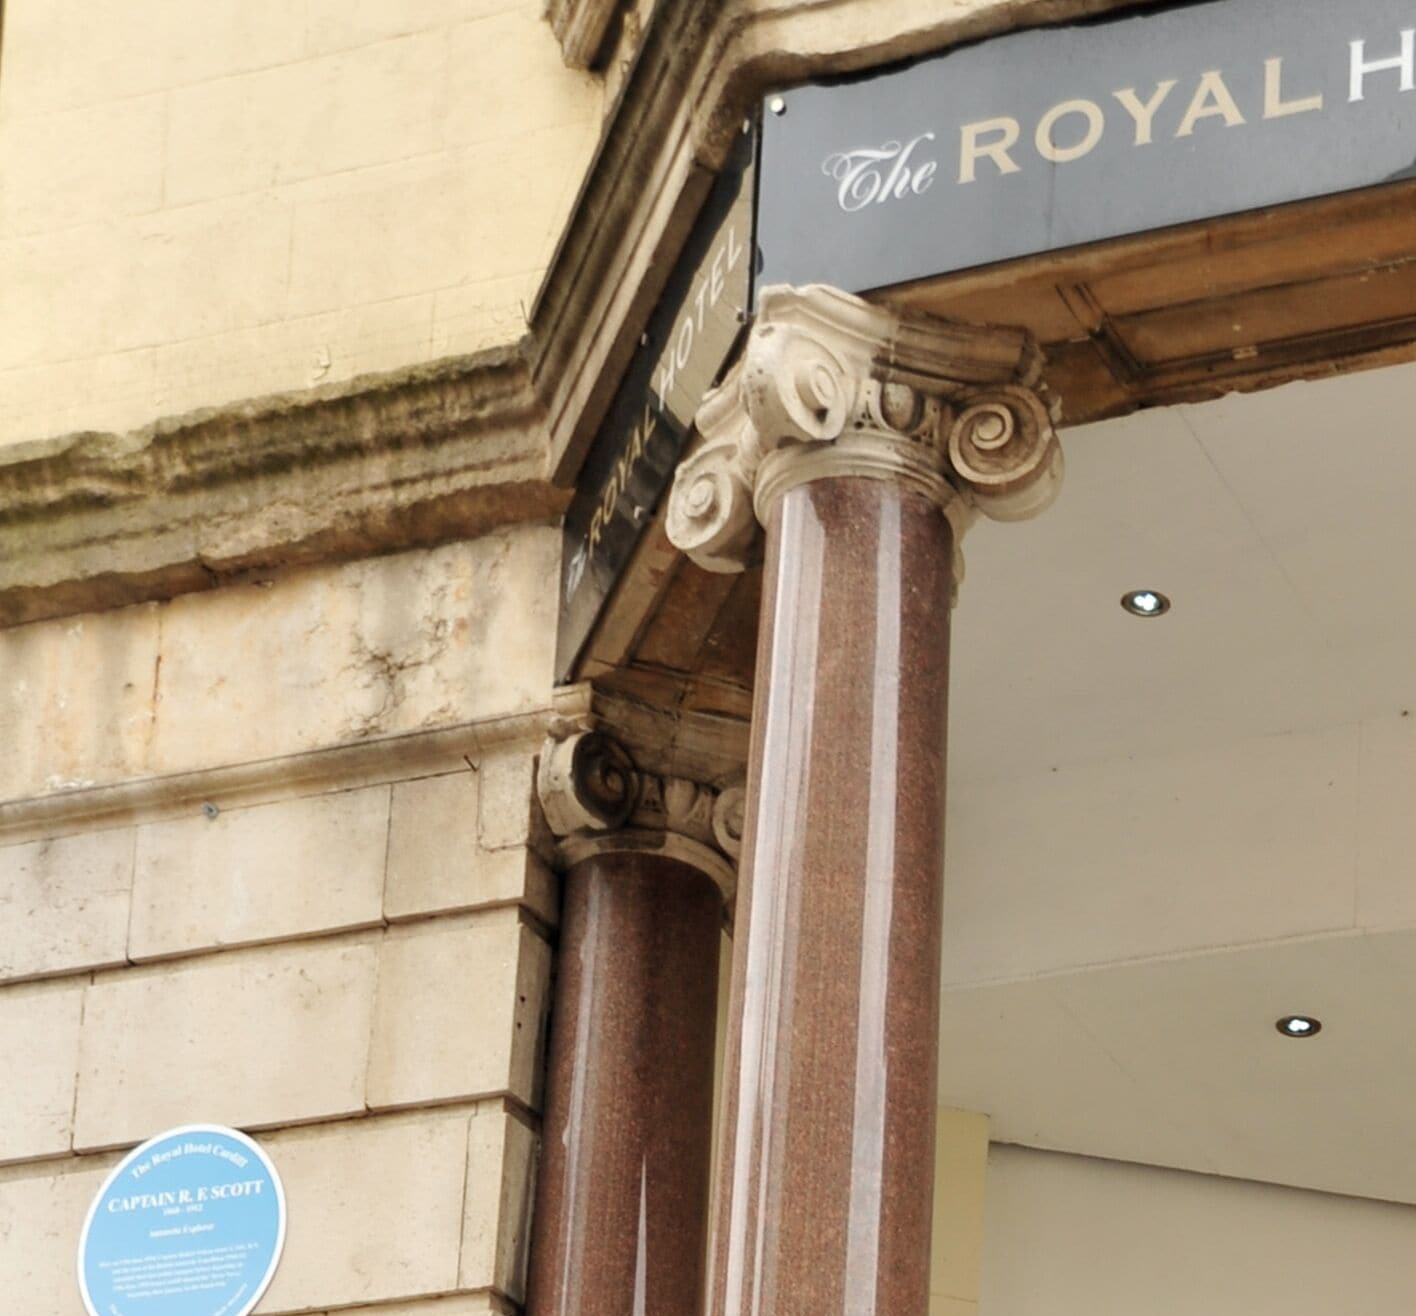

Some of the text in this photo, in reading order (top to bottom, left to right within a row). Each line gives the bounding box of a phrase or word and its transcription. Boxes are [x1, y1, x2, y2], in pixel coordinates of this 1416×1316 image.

[822, 132, 936, 213] The
[957, 55, 1324, 185] ROYAL
[659, 227, 742, 413] HOTEL
[107, 1191, 176, 1213] CAPTAIN
[210, 1179, 265, 1200] SCOTT
[151, 1144, 184, 1167] Royal
[184, 1143, 213, 1155] Hotel
